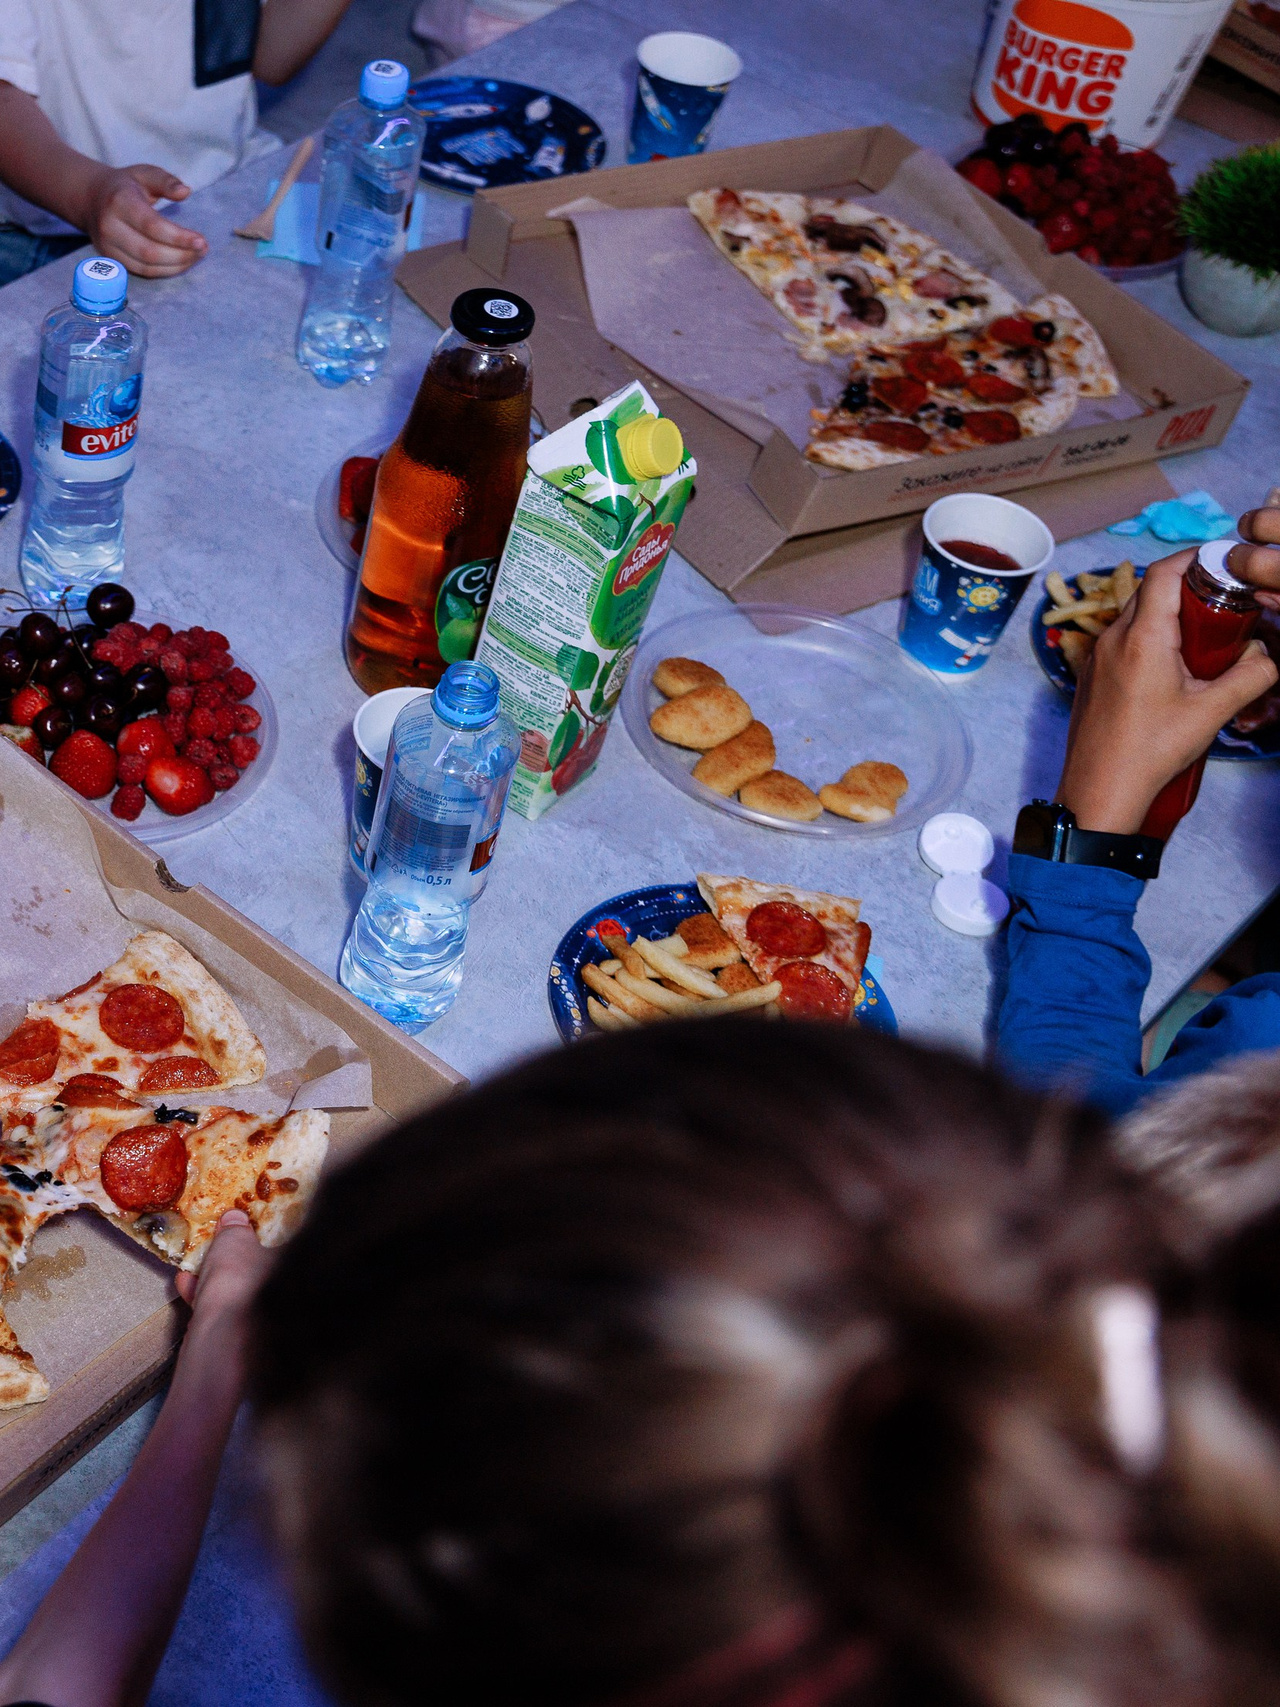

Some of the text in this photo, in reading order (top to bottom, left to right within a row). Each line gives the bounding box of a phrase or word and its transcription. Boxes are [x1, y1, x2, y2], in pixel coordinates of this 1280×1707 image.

[1005, 18, 1127, 79] BURGER
[996, 46, 1116, 116] KING
[80, 413, 139, 453] evite
[619, 539, 669, 584] Придонья
[632, 535, 661, 563] Сады
[426, 874, 443, 886] 0,5
